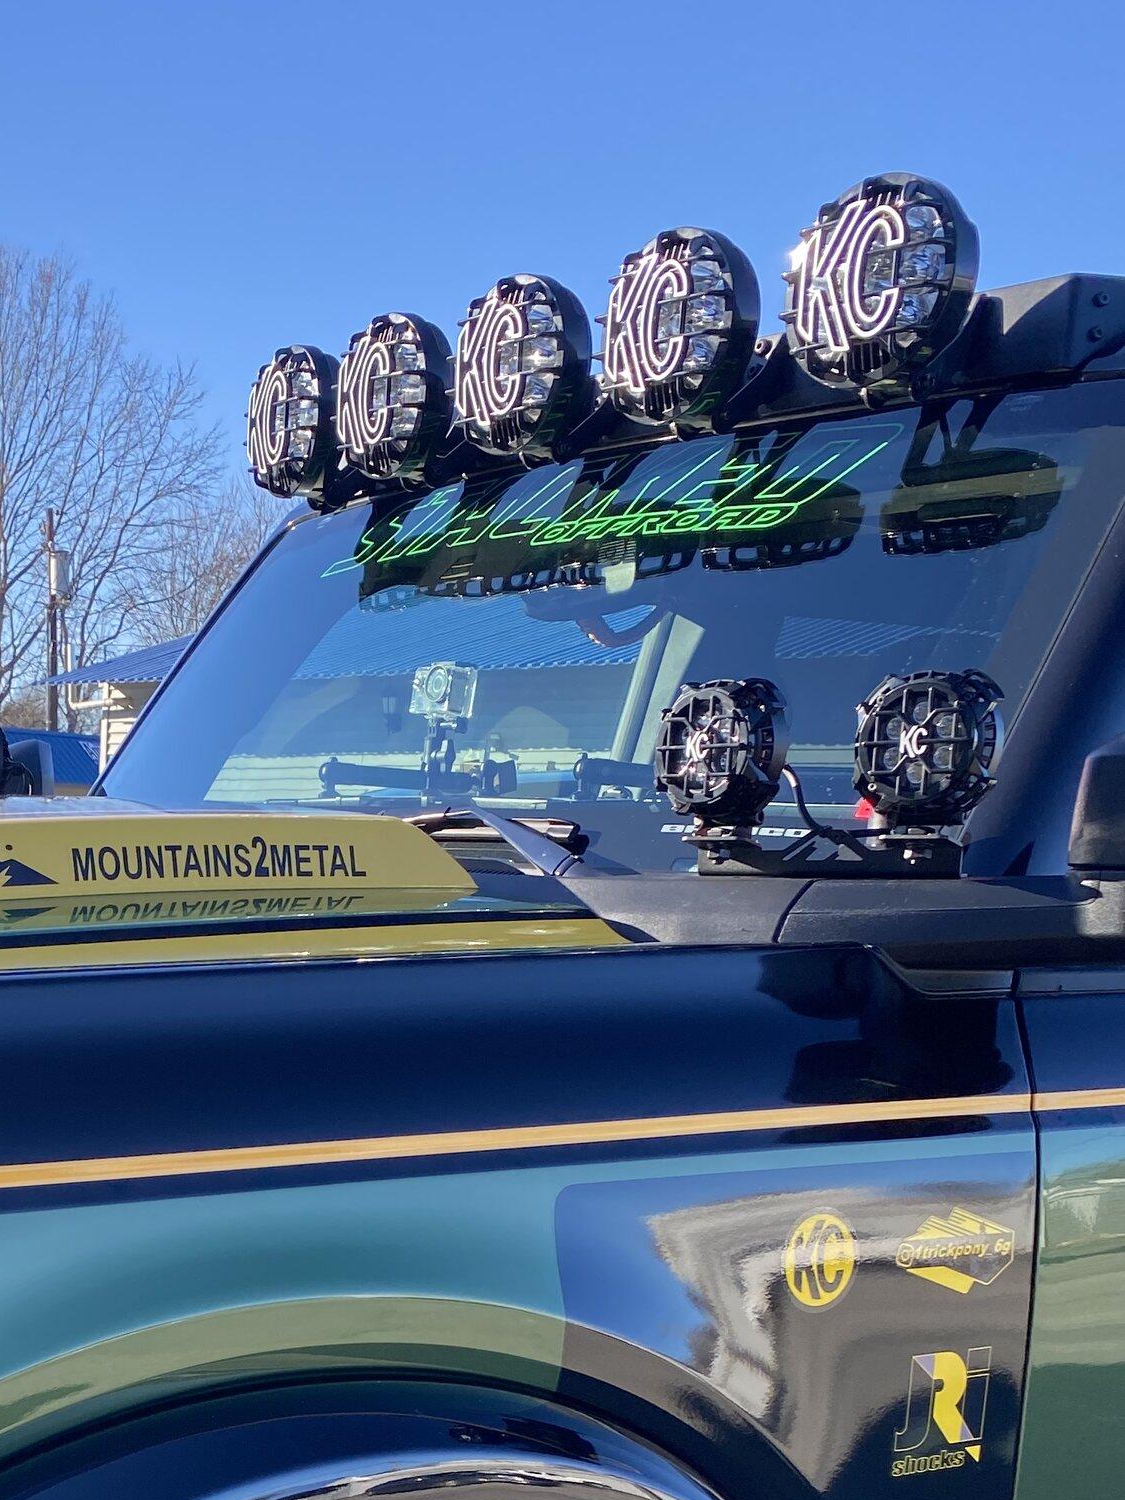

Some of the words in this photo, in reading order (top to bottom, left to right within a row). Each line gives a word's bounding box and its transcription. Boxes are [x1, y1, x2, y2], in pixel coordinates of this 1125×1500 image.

[791, 202, 905, 353] KC
[455, 300, 524, 425] KC
[605, 256, 689, 392] KC
[246, 369, 289, 473] KC
[336, 340, 389, 453] KC
[685, 732, 709, 761] KC
[899, 724, 928, 758] KC
[71, 836, 367, 882] MOUNTAINS2METAL
[792, 1221, 846, 1299] KC
[892, 1449, 966, 1477] shocks
